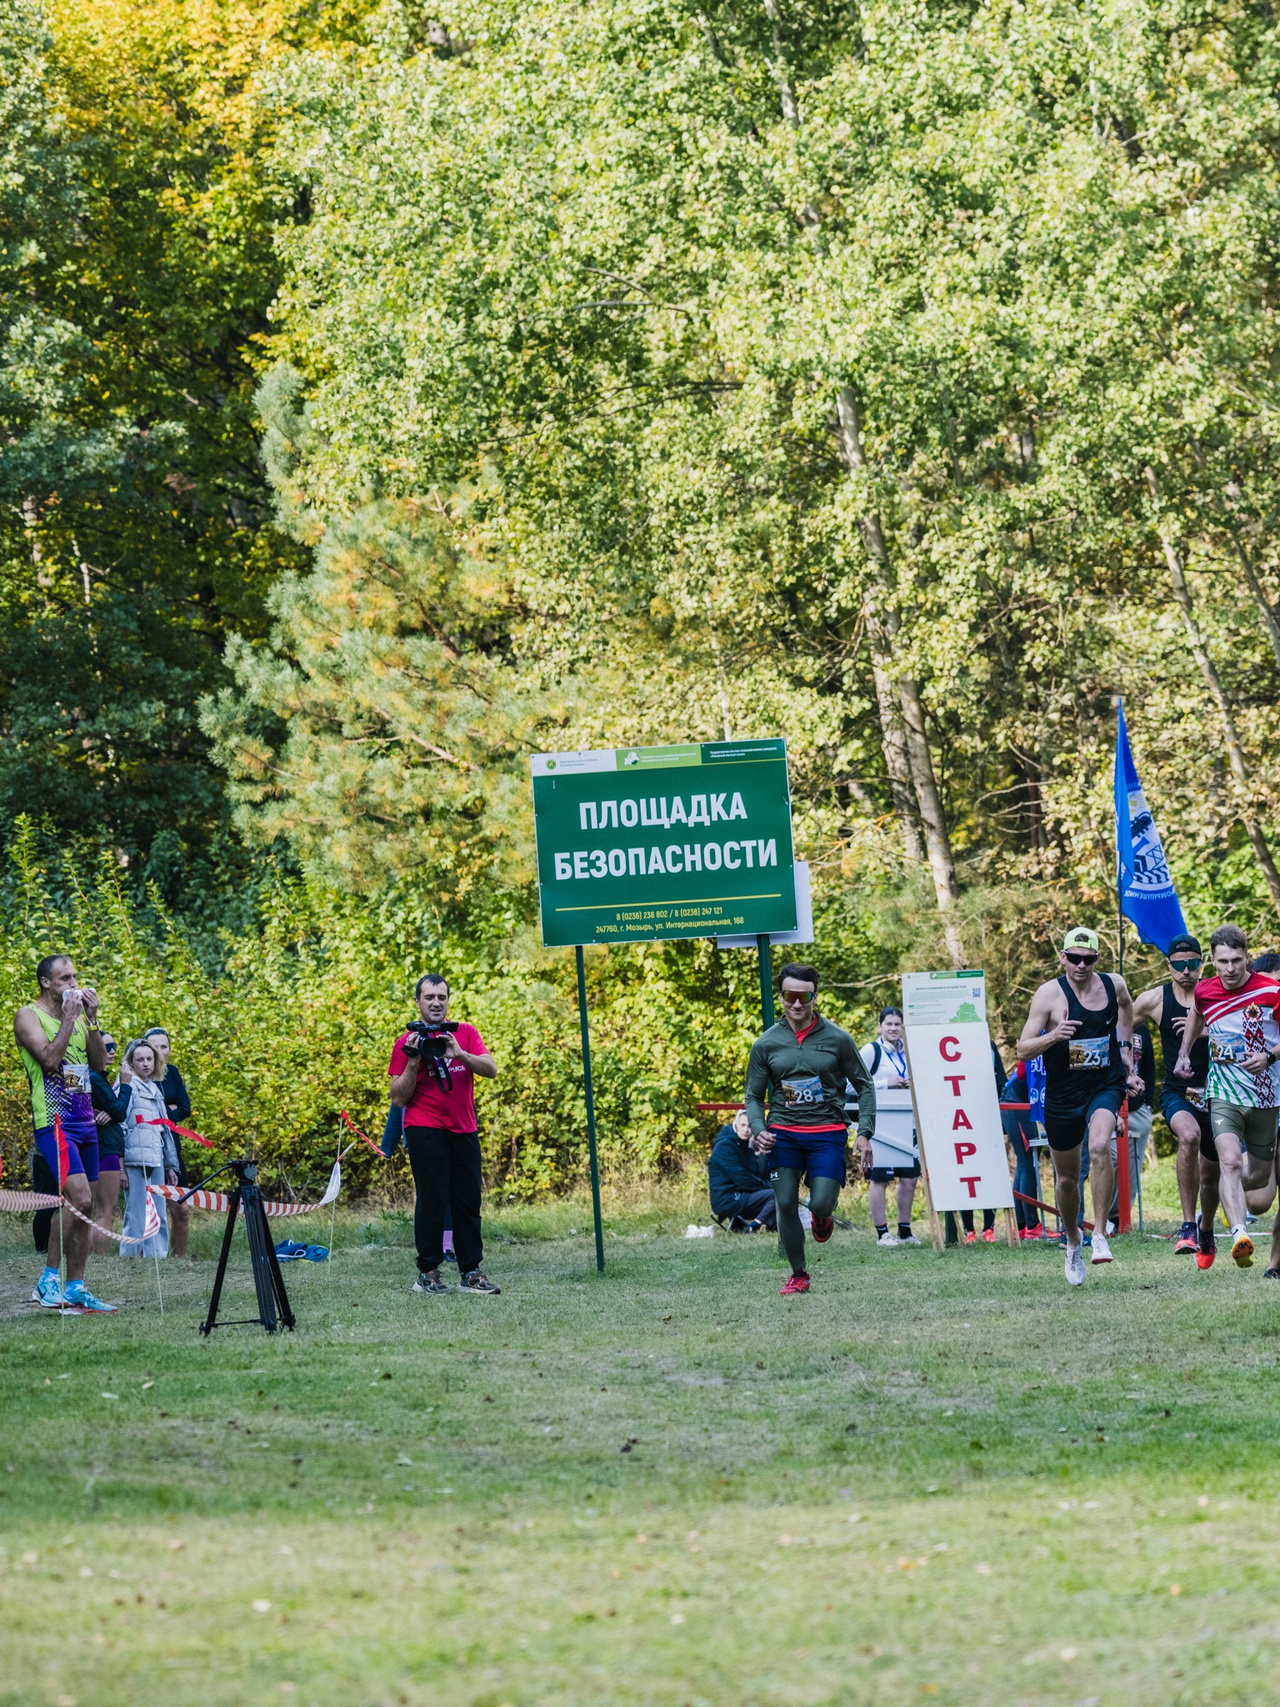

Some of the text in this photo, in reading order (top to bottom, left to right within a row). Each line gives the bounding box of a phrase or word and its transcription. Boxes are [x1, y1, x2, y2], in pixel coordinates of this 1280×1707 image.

[579, 791, 748, 830] ПЛОЩАДКА
[554, 839, 777, 880] БЕЗОПАСНОСТИ
[701, 907, 712, 915] 247
[713, 906, 723, 914] 121
[625, 923, 654, 932] Мозырь,
[1083, 1050, 1101, 1066] 23
[1216, 1044, 1234, 1060] 24
[795, 1089, 814, 1104] 28
[939, 1036, 982, 1198] СТАРТ
